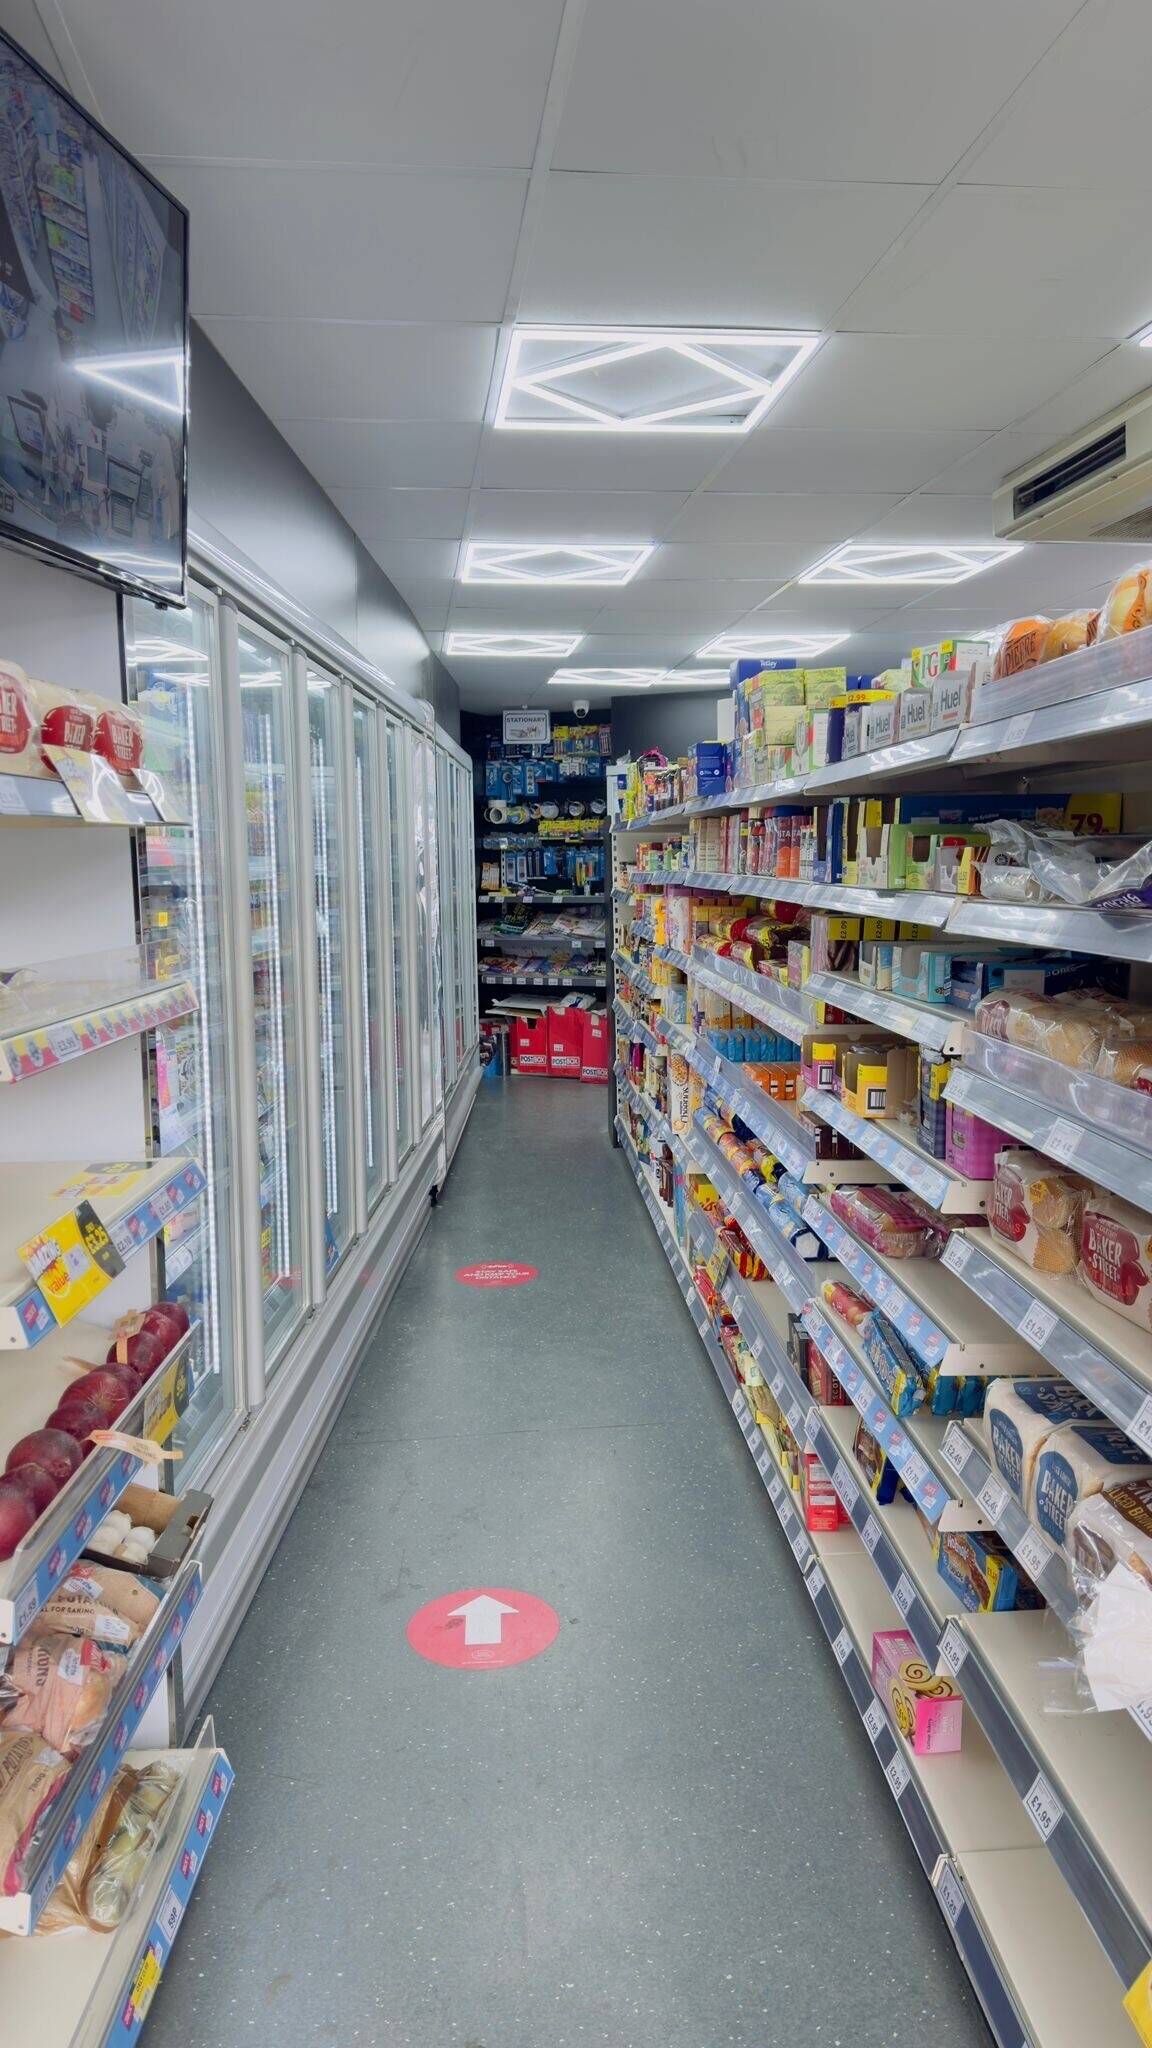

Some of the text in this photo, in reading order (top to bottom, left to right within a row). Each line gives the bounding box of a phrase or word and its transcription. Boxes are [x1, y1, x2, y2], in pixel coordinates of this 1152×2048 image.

[760, 659, 777, 669] Tetley
[941, 685, 961, 711] Huel
[876, 711, 891, 734] Huel
[907, 700, 925, 724] Huel
[111, 723, 134, 748] BAKER
[1089, 1228, 1123, 1266] BAKER
[1092, 1253, 1119, 1281] STREET
[1025, 1319, 1046, 1340] £1.29
[946, 1446, 962, 1470] £2.49
[1021, 1544, 1040, 1571] £1.95
[67, 1606, 95, 1615] BAKING
[944, 1641, 960, 1667] £1.95
[866, 1712, 879, 1735] £2.95
[888, 1765, 902, 1791] £2.95
[1031, 1795, 1052, 1829] £1.95
[943, 1885, 957, 1916] £1.25
[168, 1906, 178, 1929] 59P
